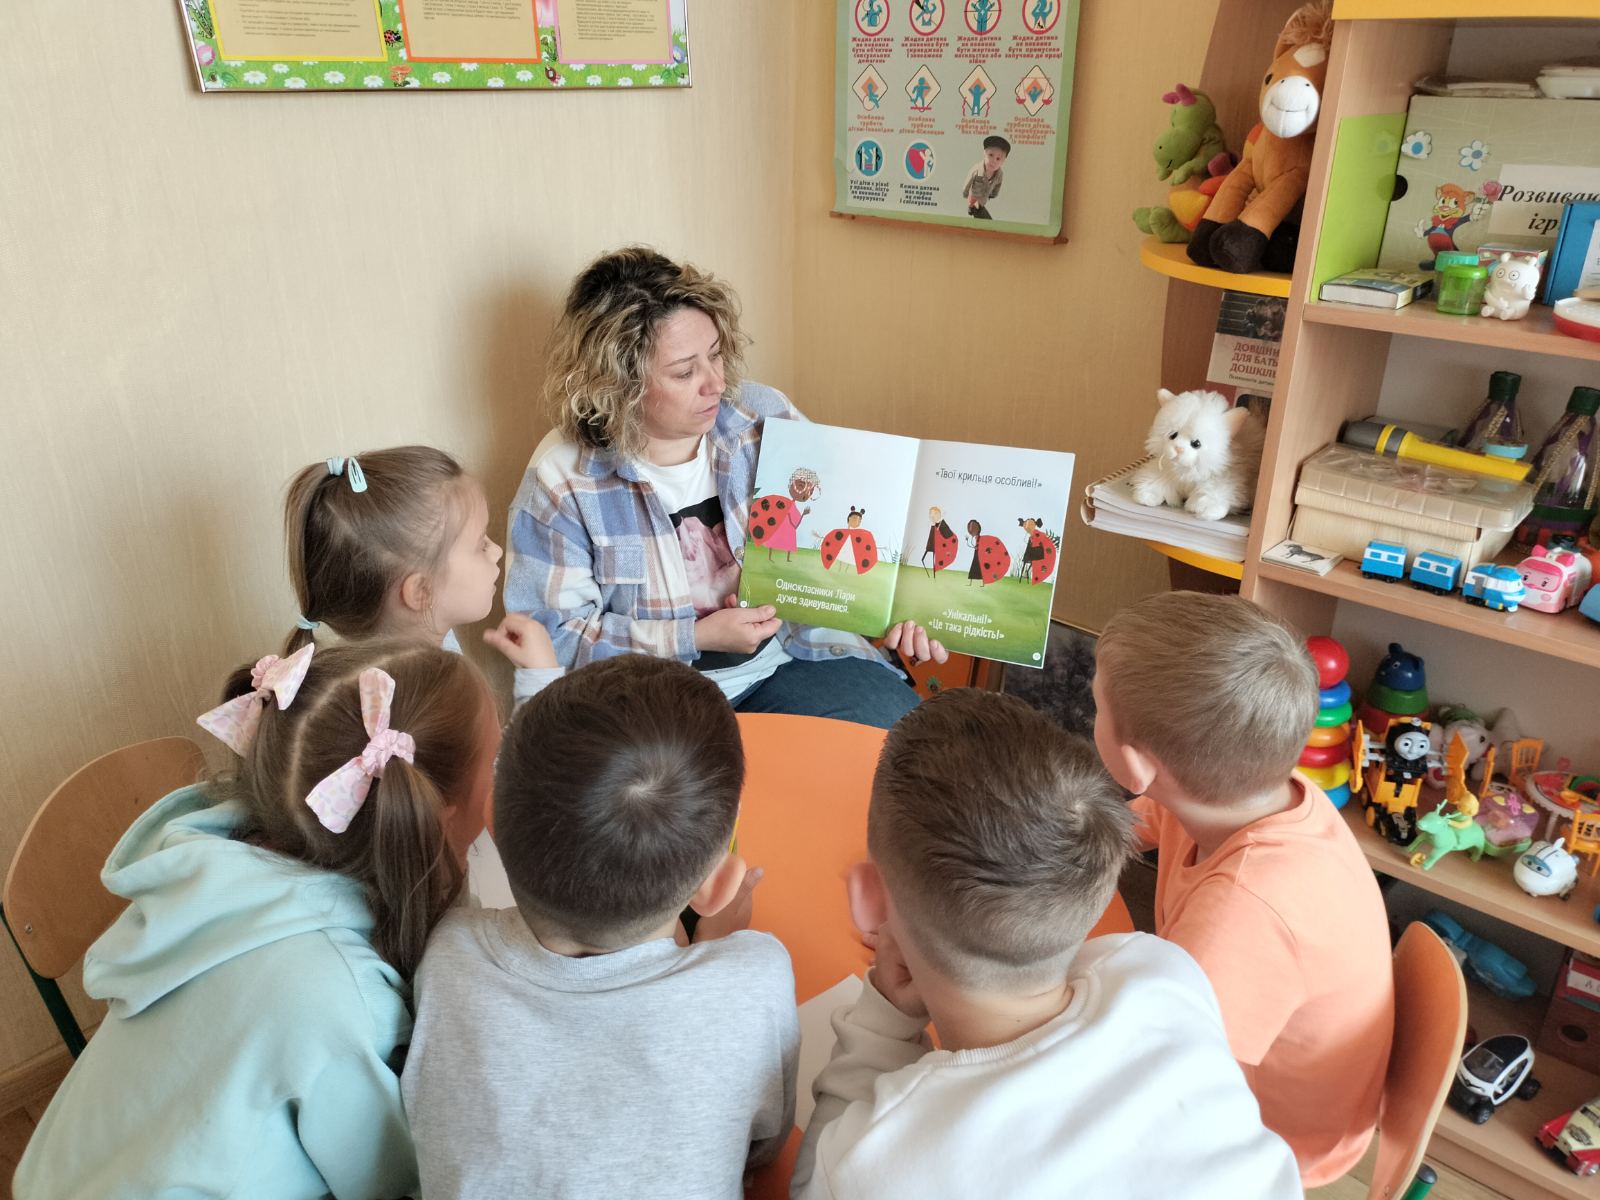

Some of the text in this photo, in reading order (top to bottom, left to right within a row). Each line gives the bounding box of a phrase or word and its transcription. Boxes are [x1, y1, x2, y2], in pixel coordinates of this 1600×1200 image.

[1528, 212, 1560, 236] ігр
[1232, 352, 1253, 363] ДЛЯ
[935, 468, 956, 479] «Твої
[958, 472, 993, 484] крильця
[775, 578, 856, 604] Однокласники Лари
[776, 593, 849, 614] дуже здивувалися.
[942, 608, 993, 625] «Унікальні!»
[928, 618, 1005, 640] «Це така рідкість!»
